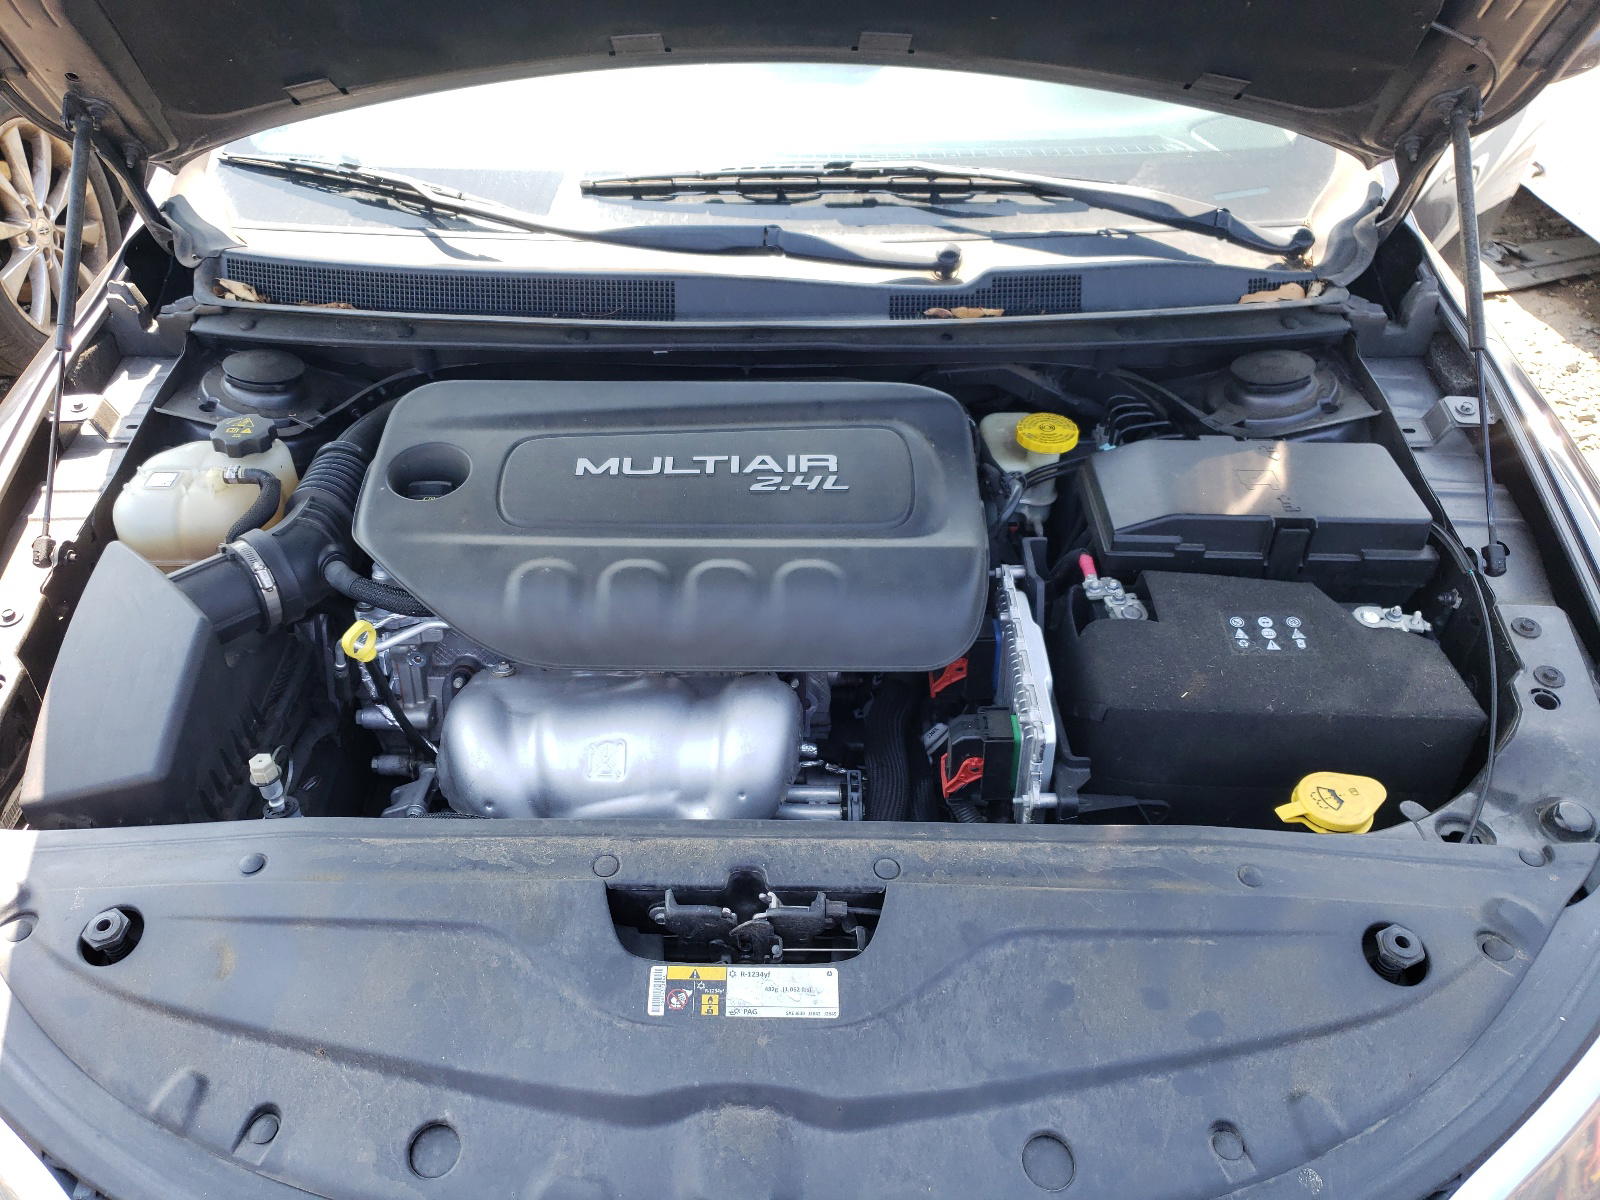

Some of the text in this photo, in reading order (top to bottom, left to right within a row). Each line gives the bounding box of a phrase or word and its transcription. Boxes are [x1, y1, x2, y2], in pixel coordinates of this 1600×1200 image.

[575, 454, 838, 476] MULTIAIR
[749, 475, 850, 491] 2.4L
[740, 970, 771, 979] R-1234yf
